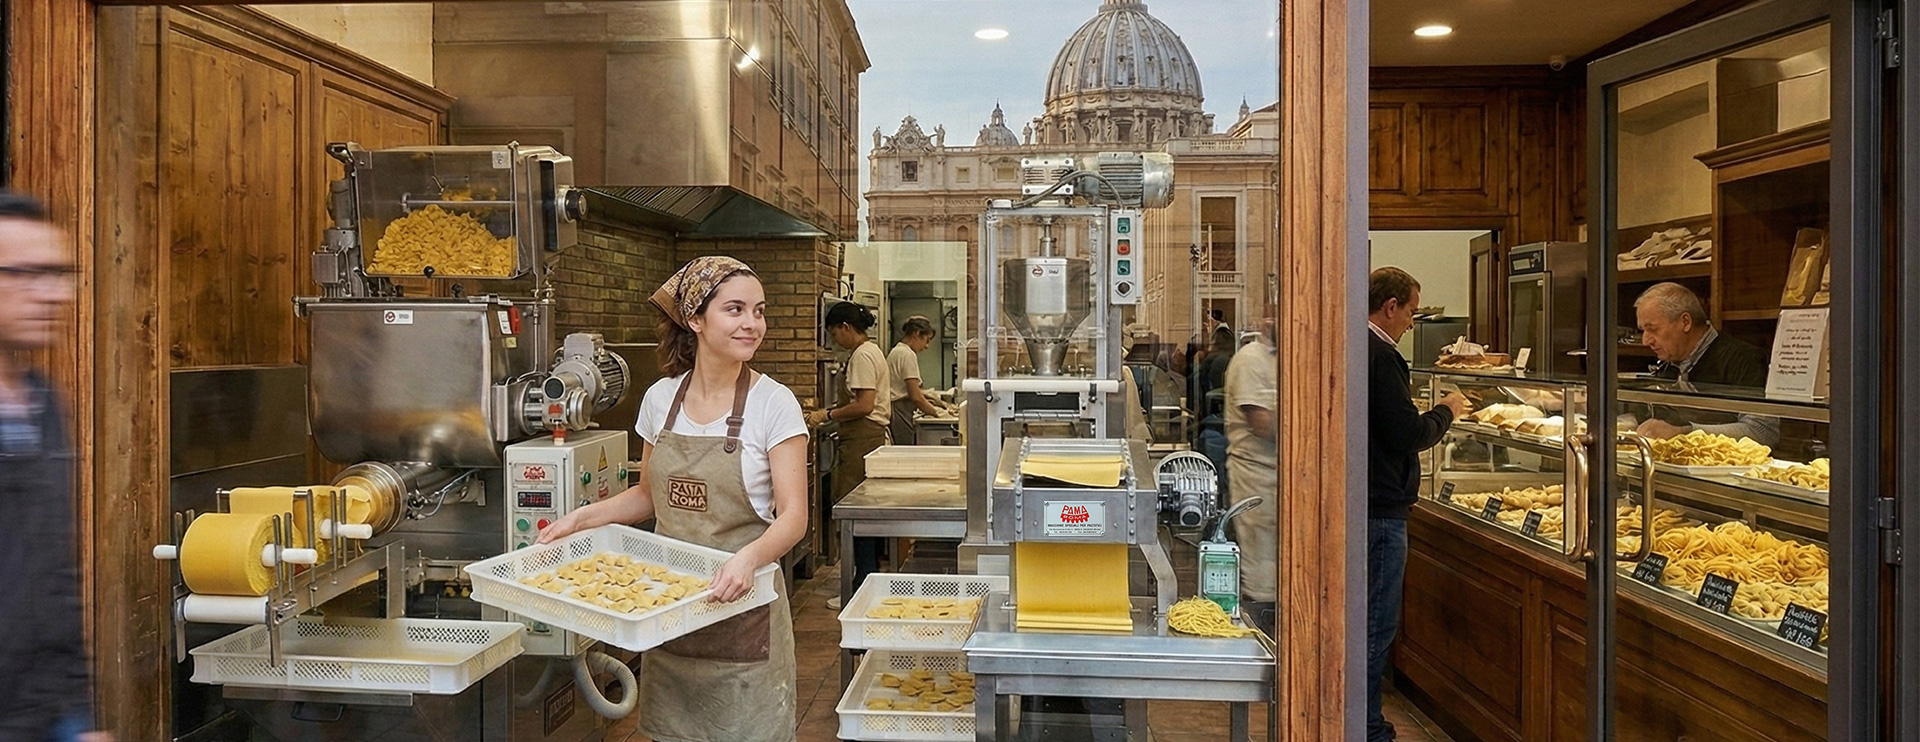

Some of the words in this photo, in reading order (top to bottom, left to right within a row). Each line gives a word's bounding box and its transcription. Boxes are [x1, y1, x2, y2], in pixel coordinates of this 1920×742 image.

[671, 482, 703, 496] PASTA
[671, 492, 706, 507] ROMA
[1062, 505, 1087, 514] PAMA
